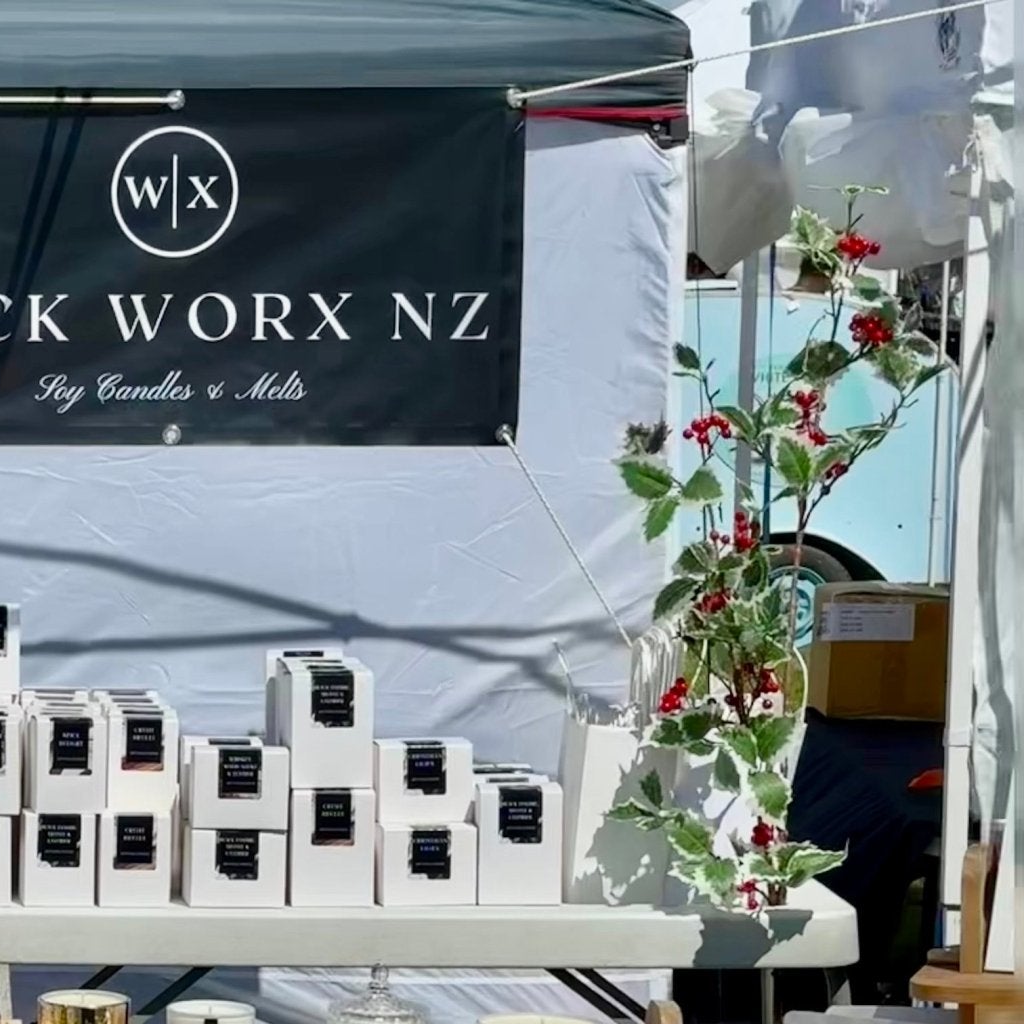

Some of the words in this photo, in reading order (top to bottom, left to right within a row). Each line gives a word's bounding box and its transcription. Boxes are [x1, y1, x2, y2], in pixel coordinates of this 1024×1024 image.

[108, 292, 353, 342] WORX
[391, 292, 490, 341] NZ
[34, 374, 84, 414] Soy
[95, 370, 193, 402] Candles
[232, 369, 308, 402] Melts
